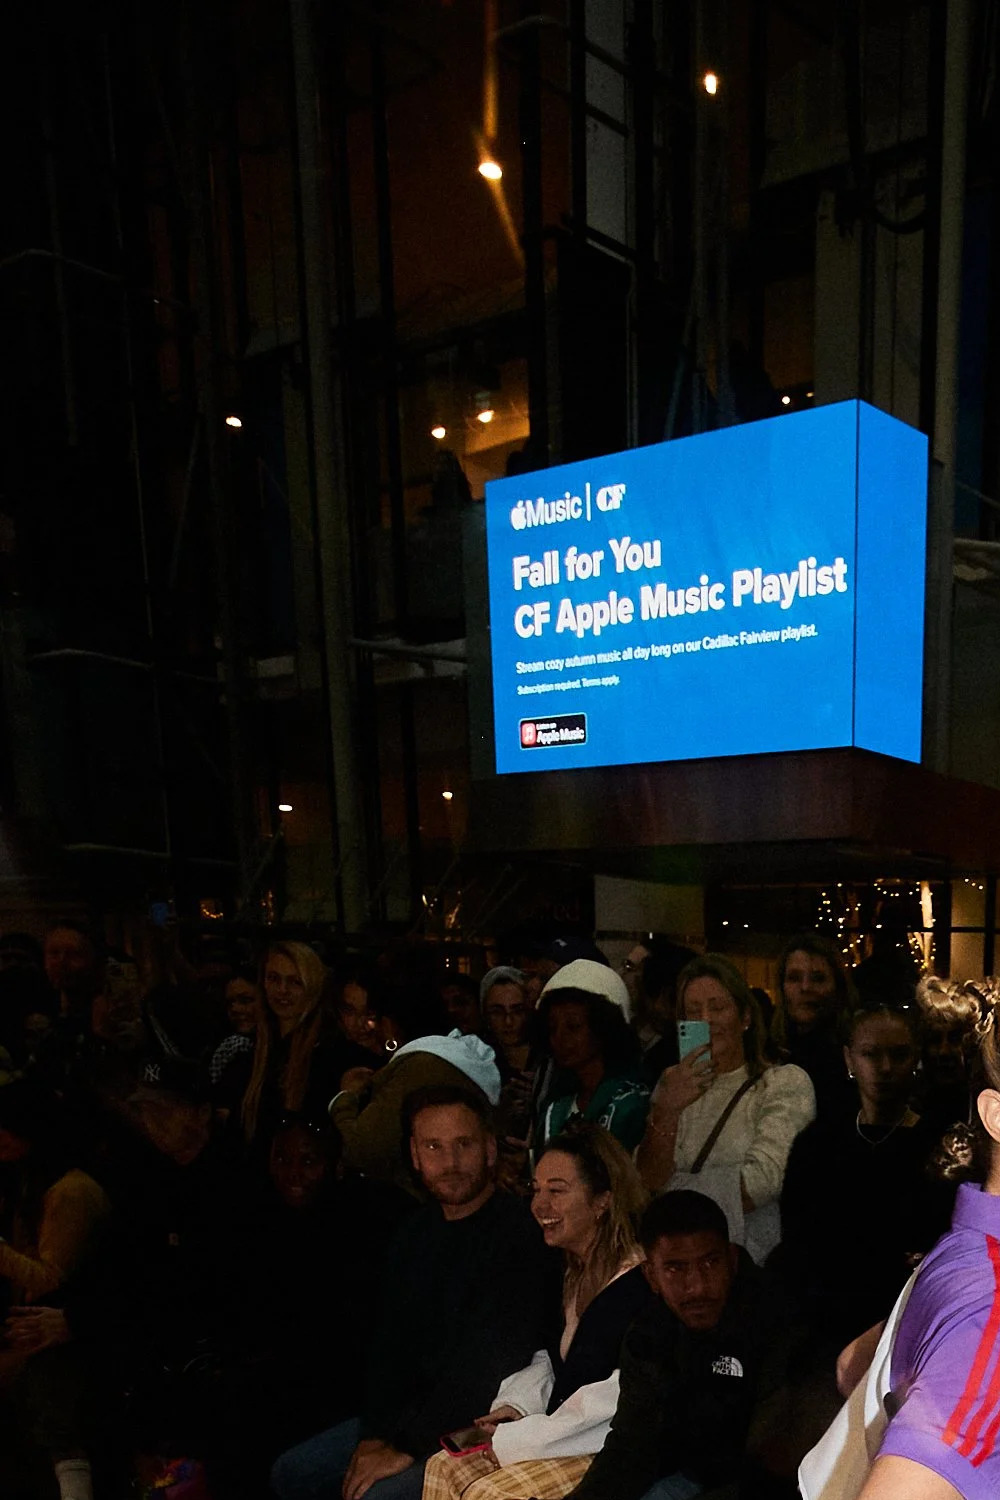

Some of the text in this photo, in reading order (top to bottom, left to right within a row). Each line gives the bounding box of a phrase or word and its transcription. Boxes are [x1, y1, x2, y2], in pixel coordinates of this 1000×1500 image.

[525, 483, 627, 528] Music CF
[512, 536, 662, 591] Fall for You
[514, 556, 848, 638] CF Apple Music Playlist
[516, 624, 819, 674] Stream cozy autumn music all day long on our Cadillac Fairview playlist.
[559, 726, 585, 741] Music
